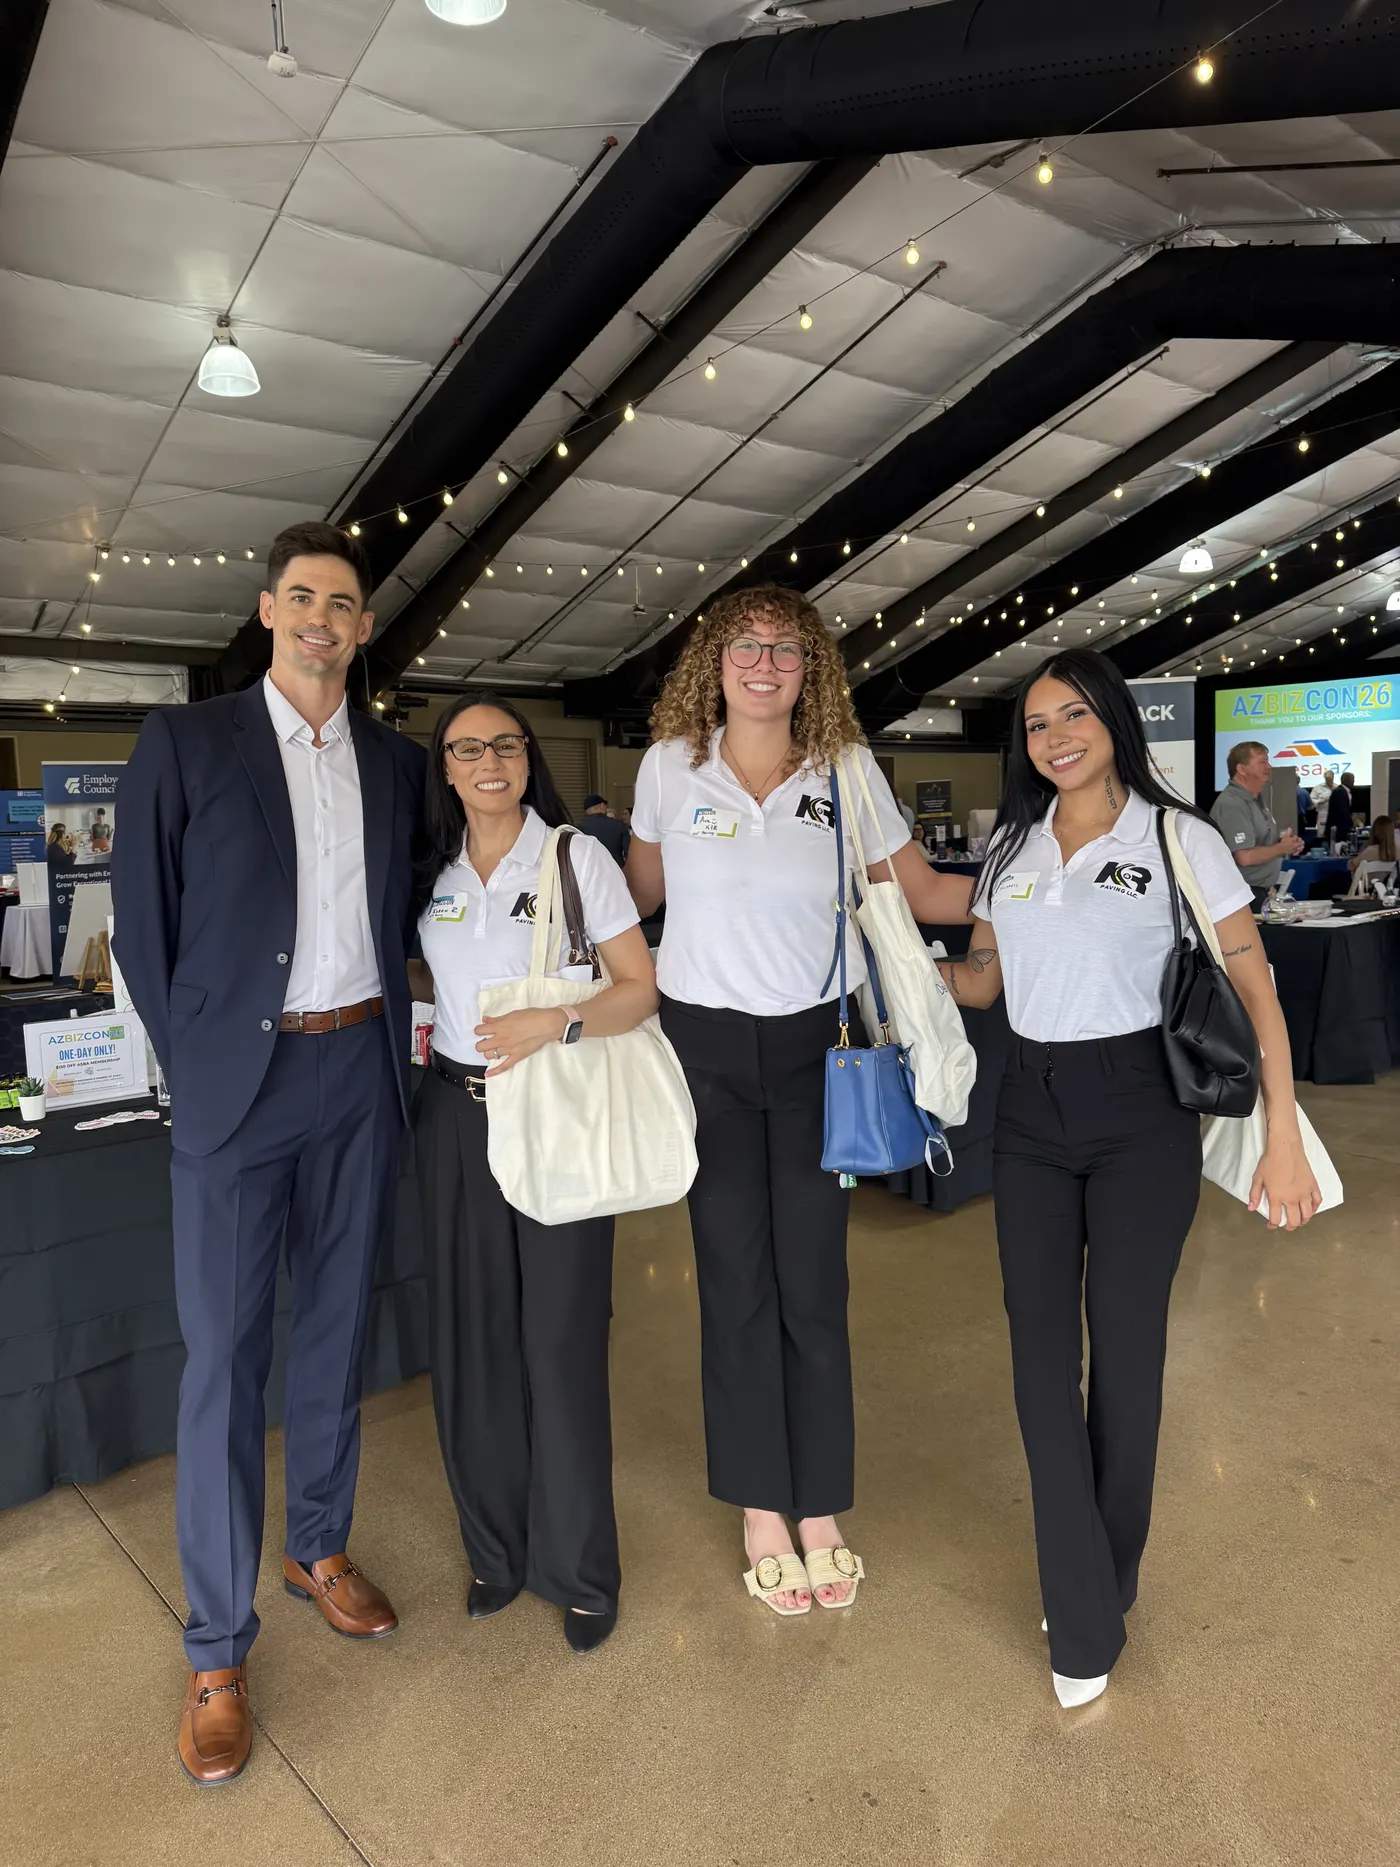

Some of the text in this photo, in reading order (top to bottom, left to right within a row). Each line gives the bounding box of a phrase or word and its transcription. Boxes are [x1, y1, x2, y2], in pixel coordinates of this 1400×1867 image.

[1232, 682, 1391, 717] AZBIZCON26
[1250, 717, 1275, 726] THANK
[1278, 716, 1294, 724] YOU
[1308, 714, 1324, 722] OUR
[1325, 710, 1372, 721] SPONSORS:
[801, 819, 822, 829] PAVING
[56, 872, 89, 880] Partnering
[89, 870, 102, 878] with
[56, 881, 72, 889] Grow
[1100, 884, 1126, 894] PAVING
[515, 918, 536, 926] PAVIN
[48, 1029, 124, 1045] AZBIZCON26
[59, 1044, 116, 1061] ONE-DAY ONLY!
[90, 1057, 121, 1065] MEMBERSHIP
